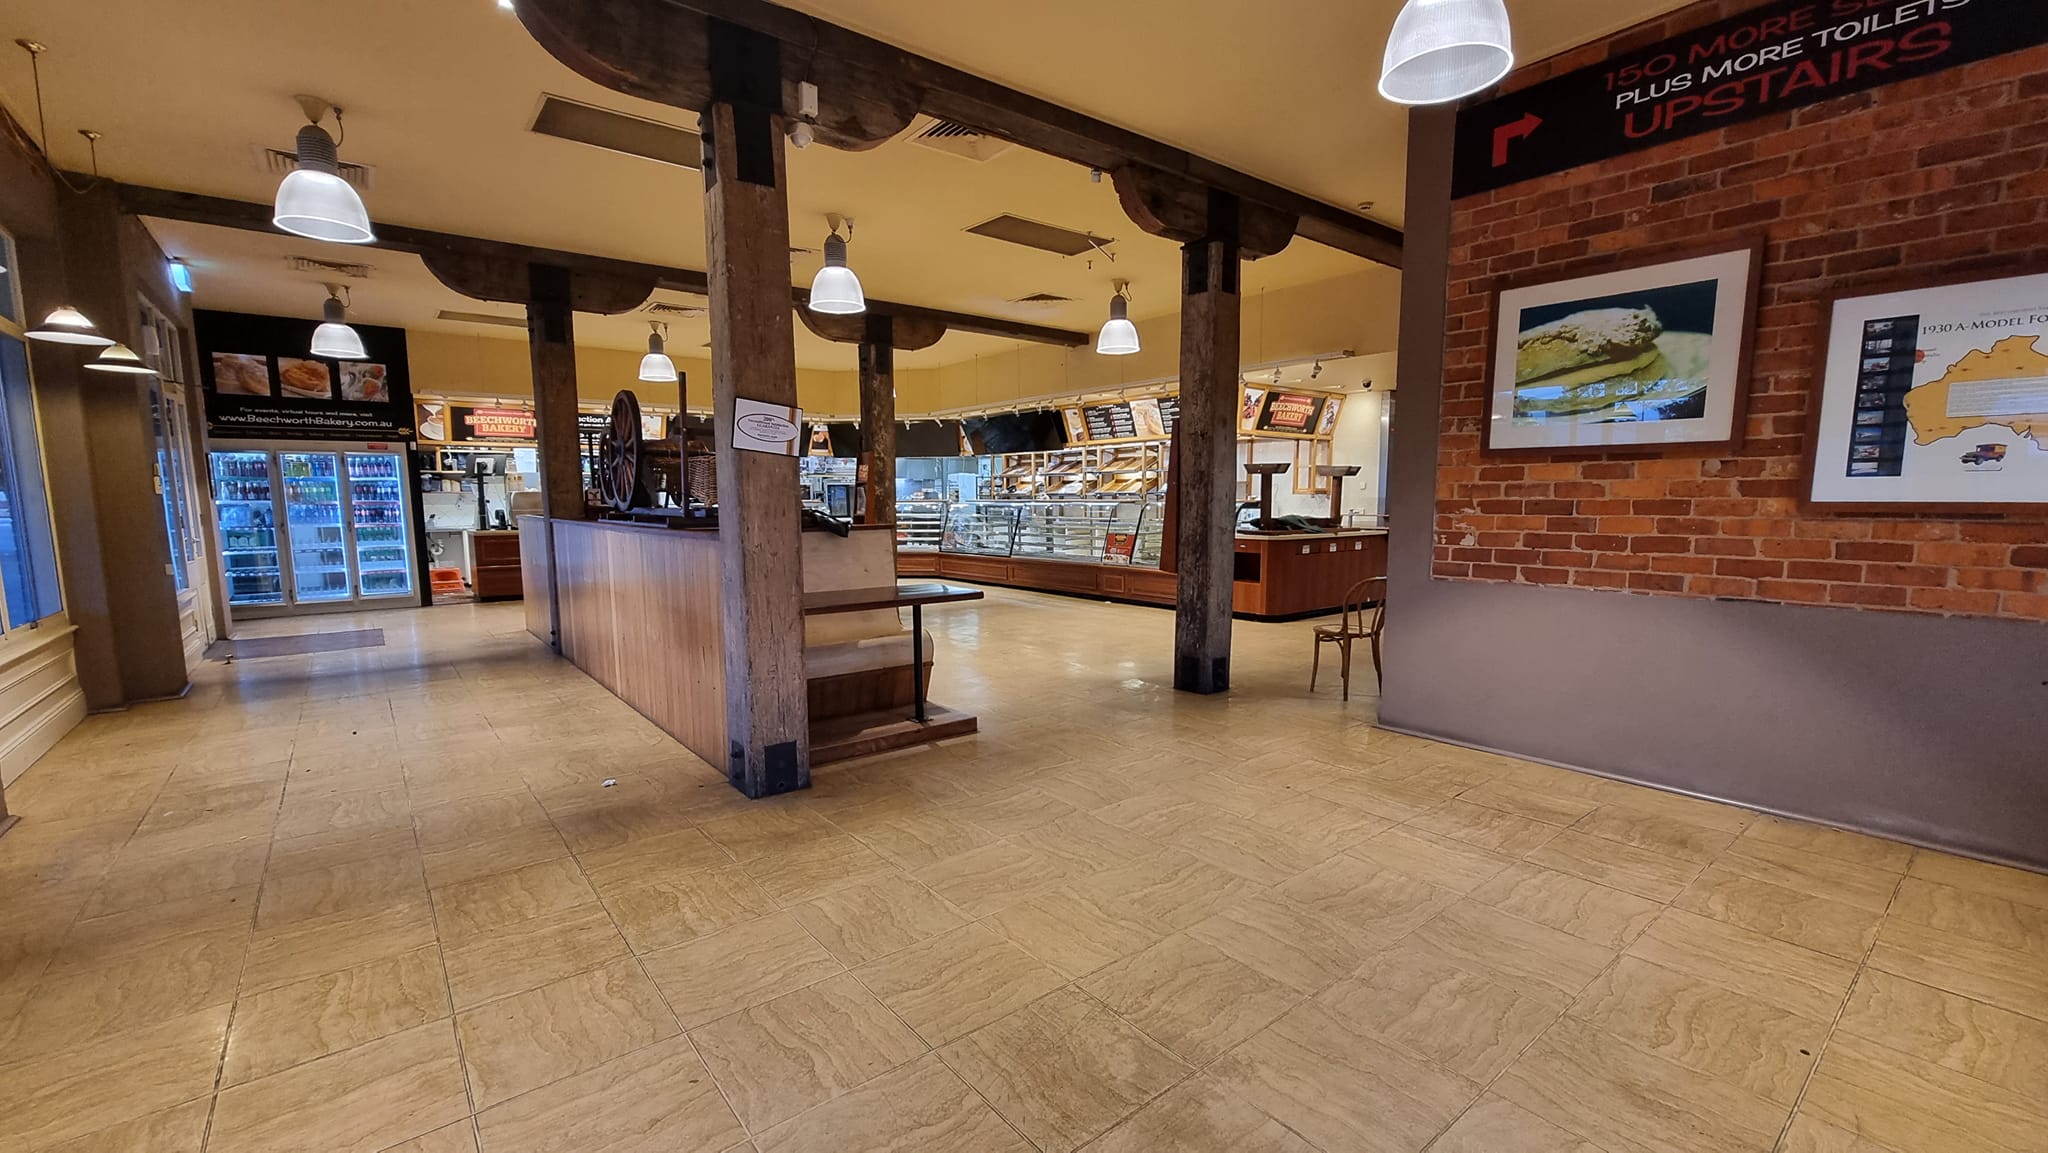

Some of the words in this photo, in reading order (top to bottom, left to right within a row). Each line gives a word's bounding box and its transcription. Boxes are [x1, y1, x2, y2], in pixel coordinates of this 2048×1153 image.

[1604, 53, 1676, 92] 150
[1689, 4, 1817, 64] MORE
[1616, 73, 1692, 109] PLUS
[1701, 37, 1804, 83] MORE
[1623, 21, 1953, 139] UPSTAIRS
[1922, 323, 1952, 335] 1930
[1954, 317, 2024, 331] A-MODEL
[1269, 402, 1315, 416] BEECHWORTH
[1276, 411, 1304, 421] BAKERY
[218, 414, 393, 427] www.BeechworthBakery.com.au
[482, 424, 527, 433] BAKERY
